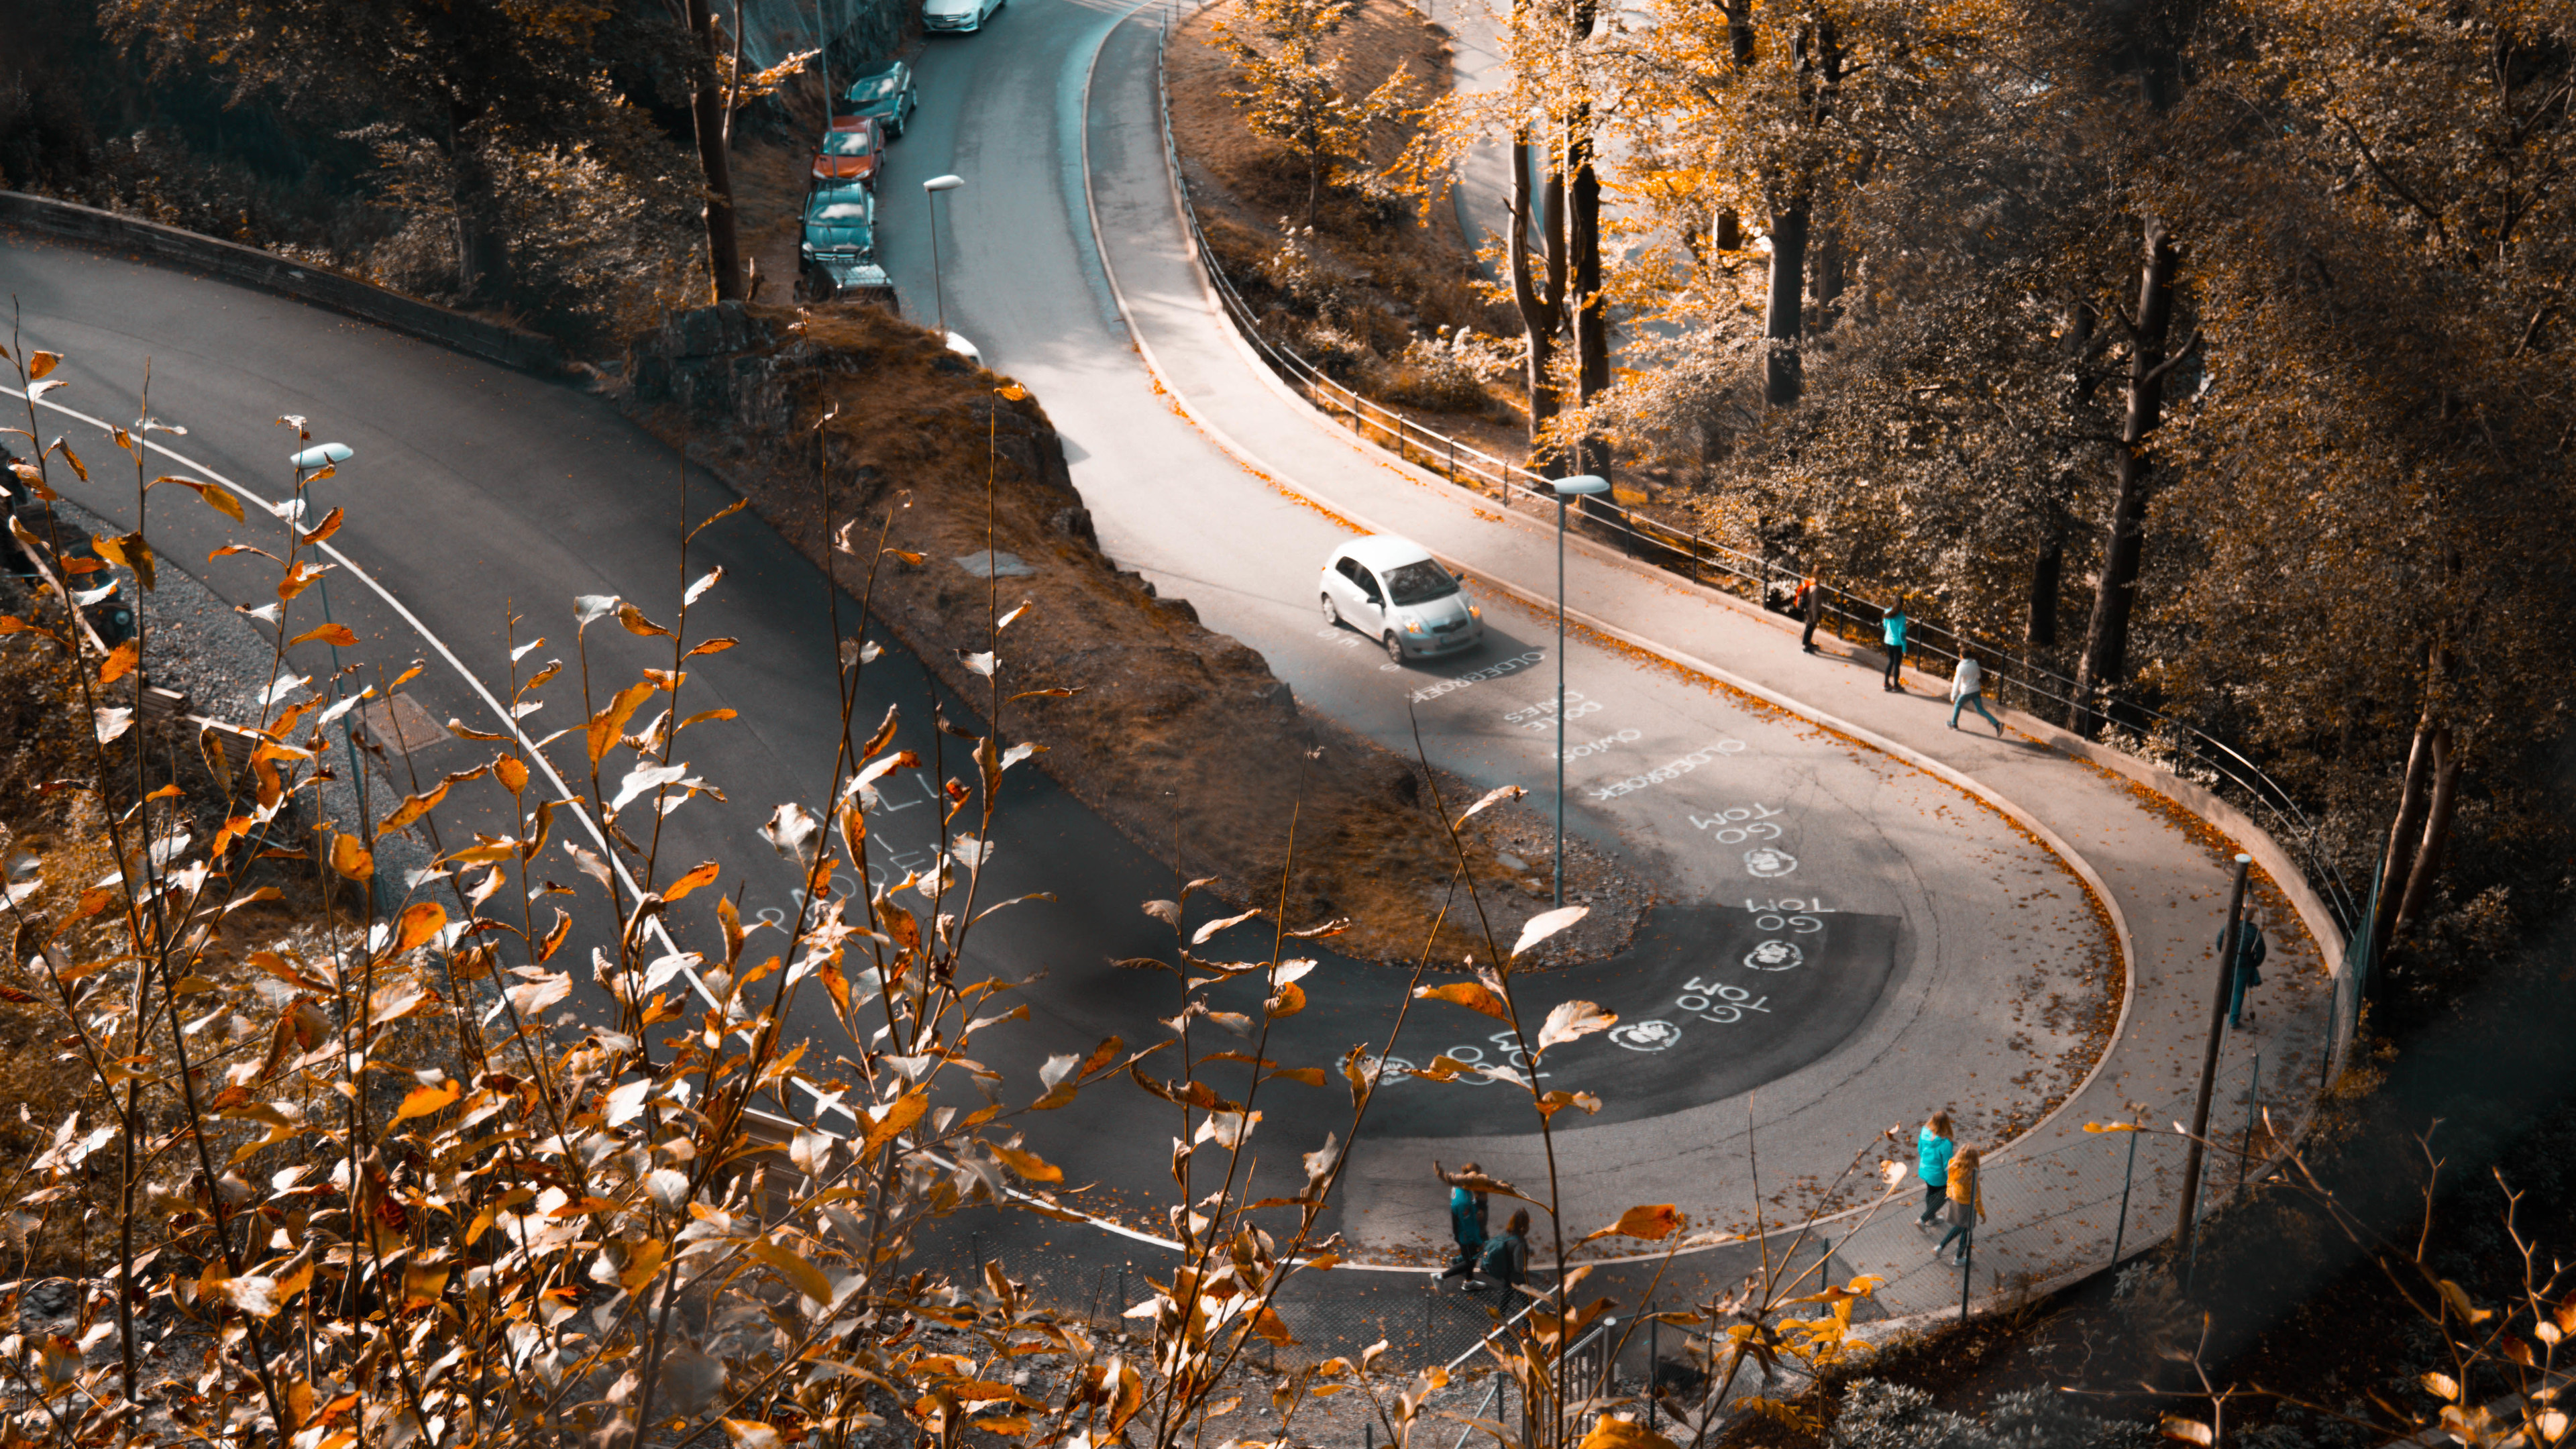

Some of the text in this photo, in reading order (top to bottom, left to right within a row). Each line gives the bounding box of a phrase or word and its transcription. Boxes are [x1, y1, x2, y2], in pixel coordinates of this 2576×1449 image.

[1589, 739, 1746, 800] OLDEBROEK
[1689, 803, 1784, 829] TOM
[1716, 822, 1782, 843] GO
[1746, 897, 1835, 913] TOM
[1756, 915, 1823, 933] GO
[1682, 976, 1771, 1012] TOM
[1675, 994, 1741, 1023] GO
